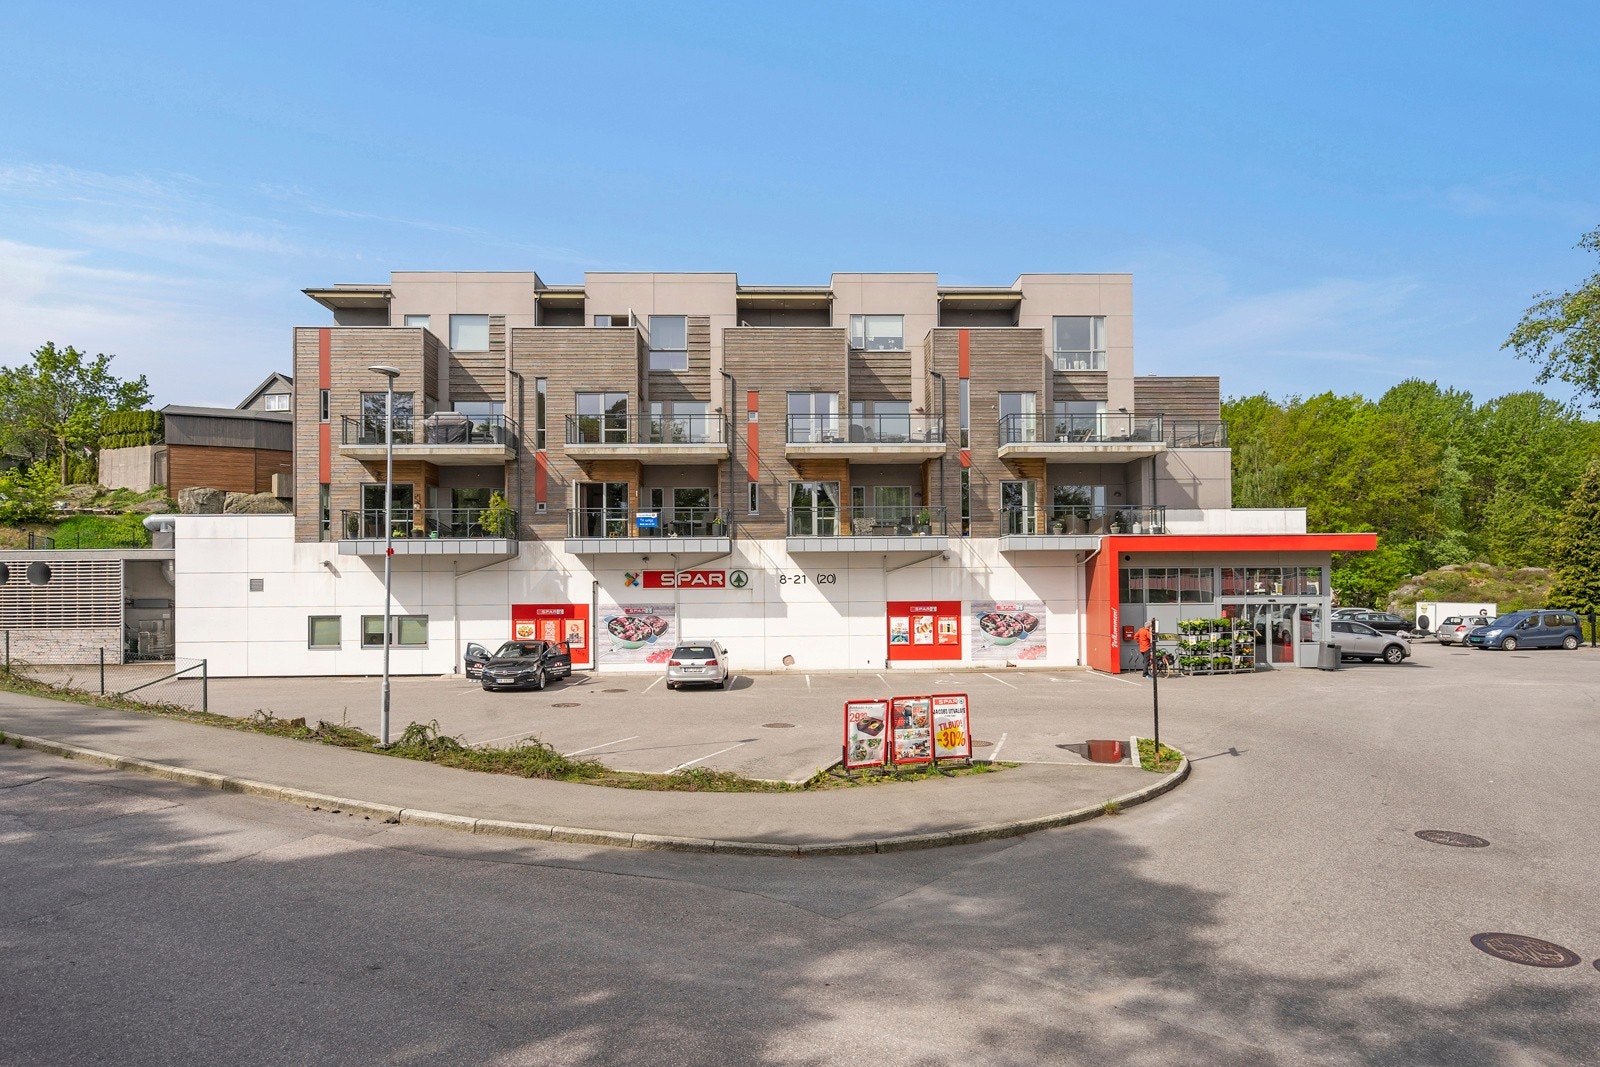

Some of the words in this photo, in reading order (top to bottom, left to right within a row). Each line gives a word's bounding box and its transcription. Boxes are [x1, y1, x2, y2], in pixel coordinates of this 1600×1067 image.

[660, 573, 724, 586] SPAR
[779, 574, 807, 584] 8-21
[816, 573, 837, 585] (20)
[937, 731, 966, 748] -30%
